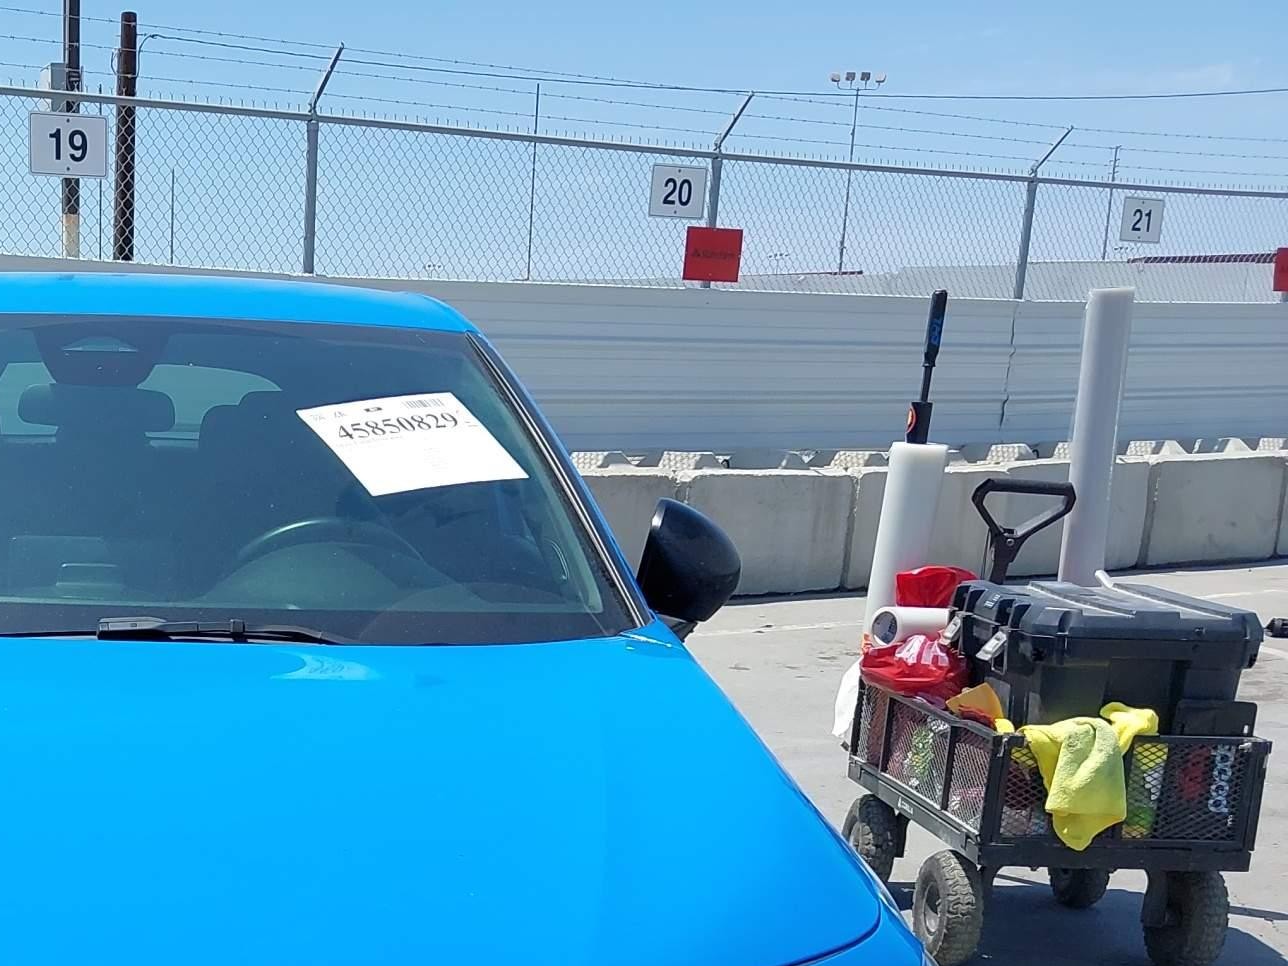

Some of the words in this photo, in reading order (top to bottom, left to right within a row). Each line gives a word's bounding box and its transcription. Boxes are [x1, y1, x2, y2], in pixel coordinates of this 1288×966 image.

[48, 127, 88, 163] 19
[662, 177, 693, 207] 20
[1130, 208, 1153, 233] 21
[338, 411, 459, 440] 45850829
